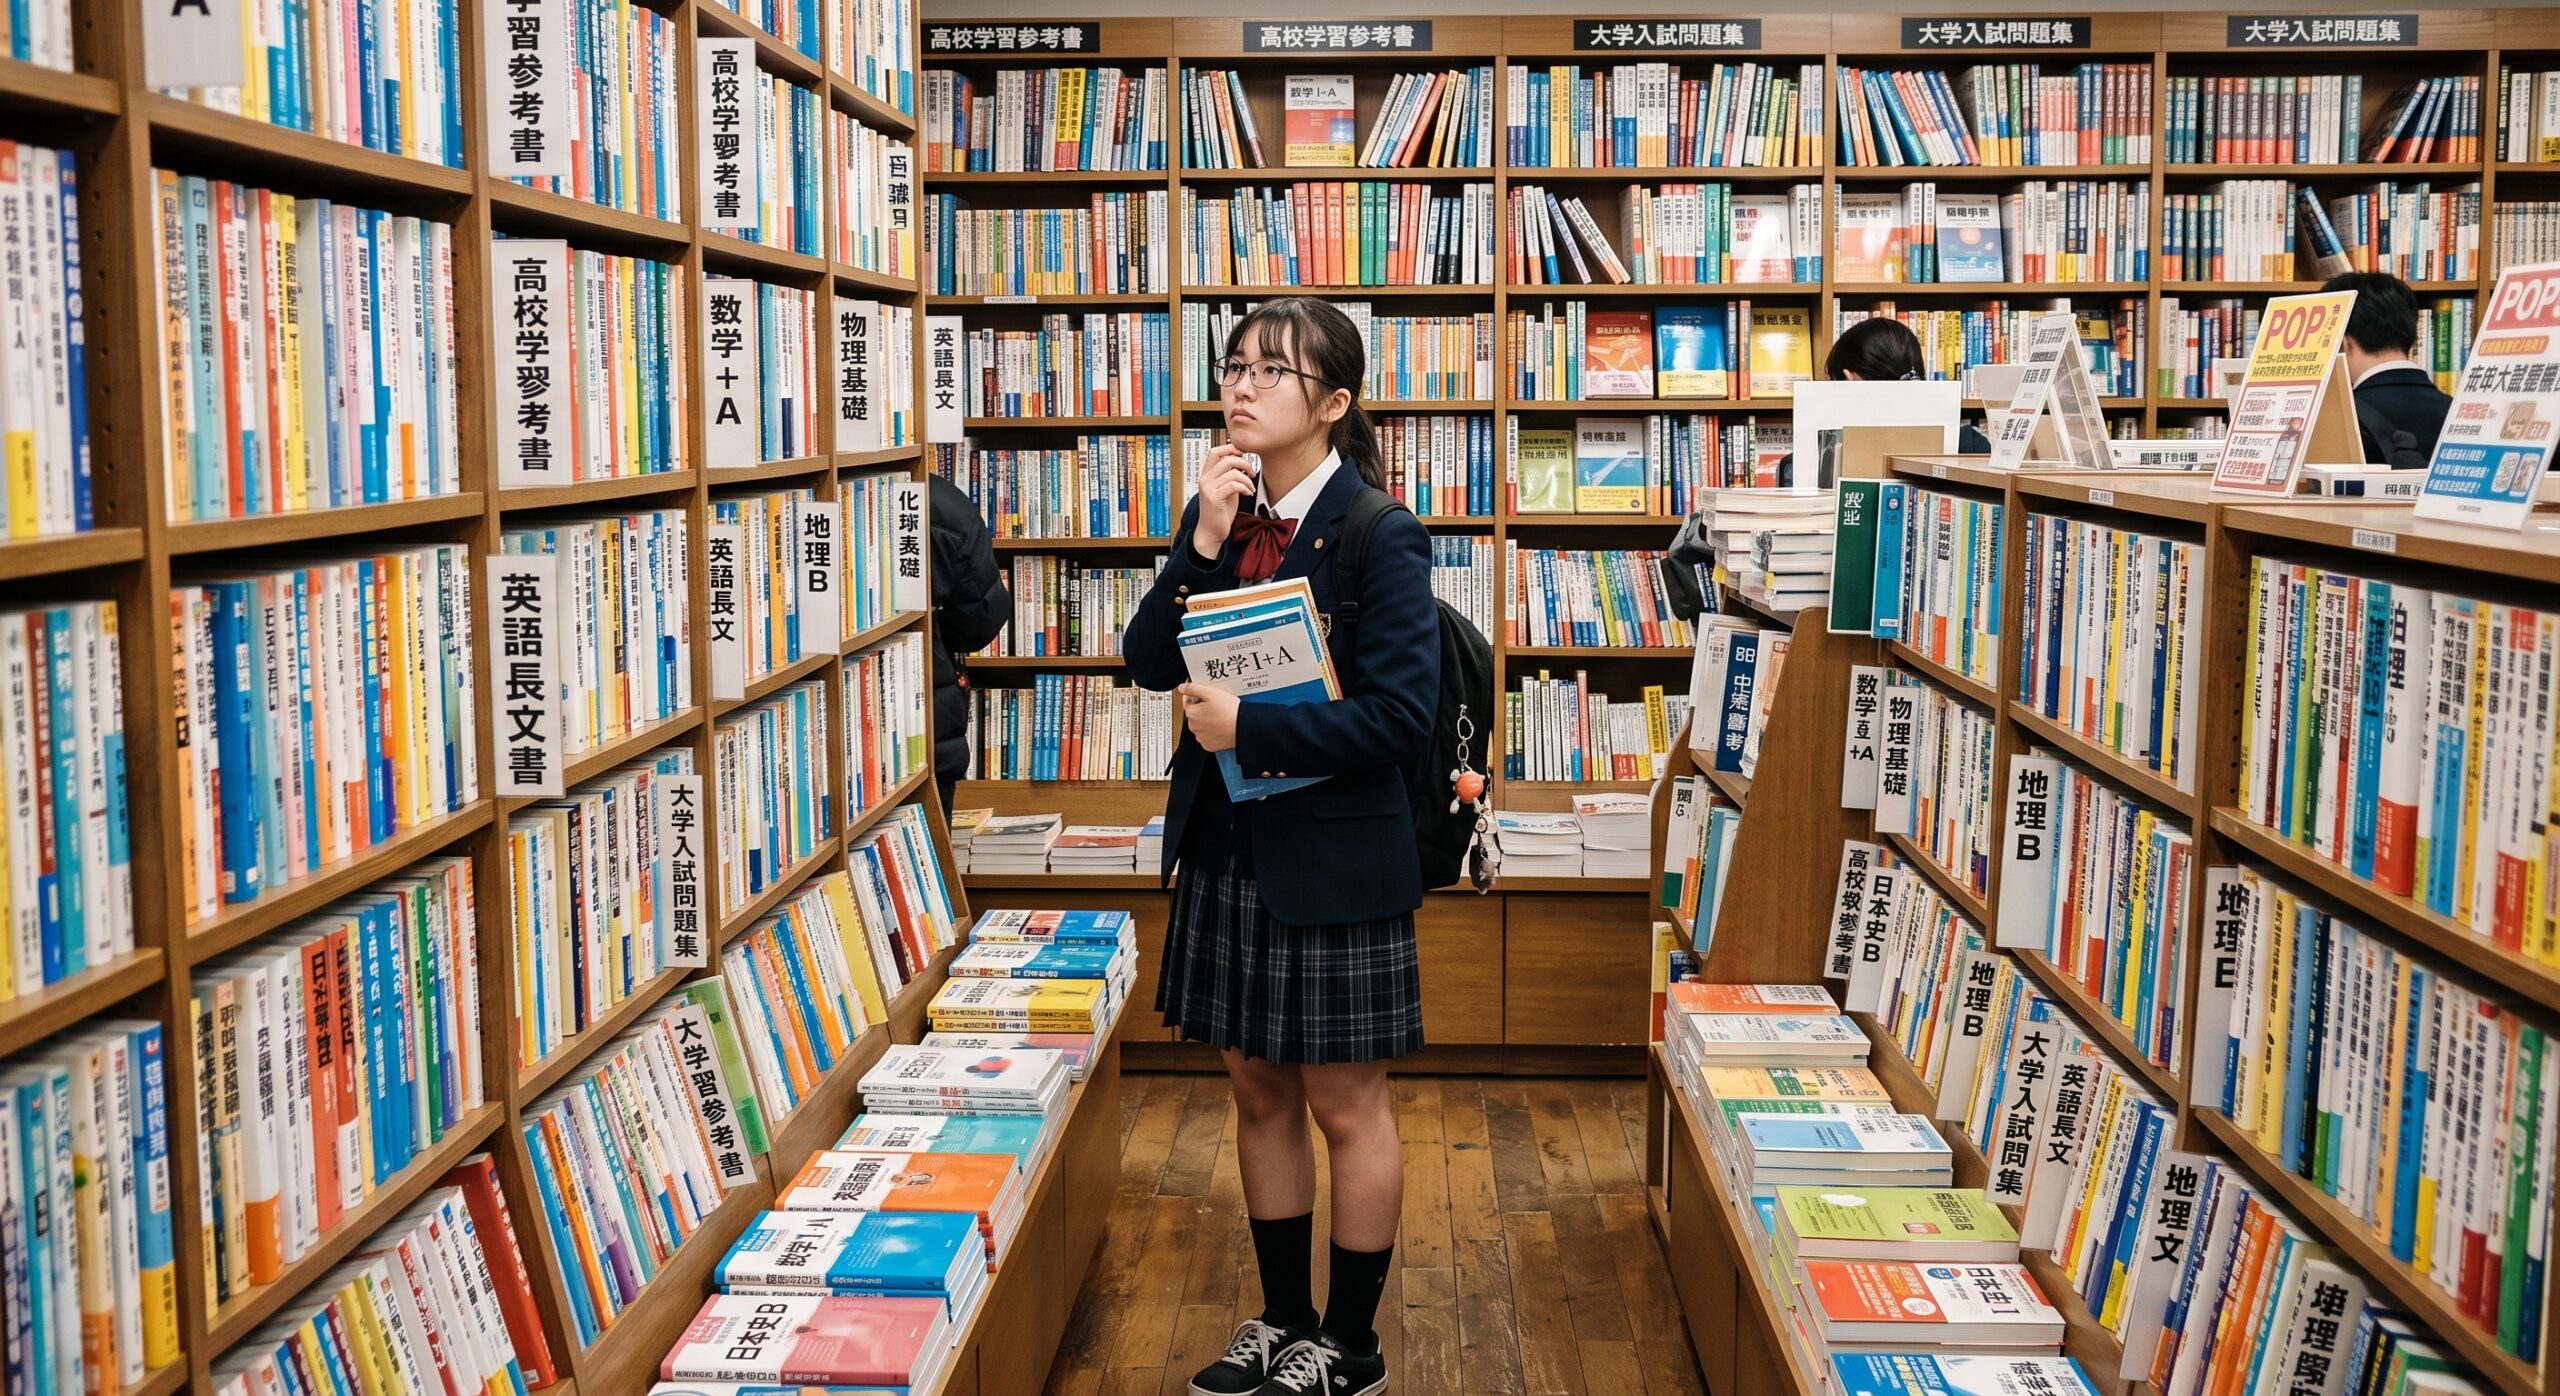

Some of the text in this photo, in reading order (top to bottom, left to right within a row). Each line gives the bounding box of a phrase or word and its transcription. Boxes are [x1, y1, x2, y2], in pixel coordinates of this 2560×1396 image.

[930, 25, 1083, 50] 高校学習参考書
[1260, 24, 1414, 49] 高校学習参考書
[1590, 23, 1745, 47] 大学入試問題集
[1918, 22, 2074, 46] 大学入試問題集
[2245, 20, 2402, 43] 大学入試問題集
[840, 311, 868, 422] 物理基礎
[2261, 304, 2327, 351] POP
[709, 537, 736, 643] 英語長文
[804, 511, 832, 594] 地理B
[501, 572, 547, 786] 英語長文書
[1883, 696, 1913, 797] 物理基礎
[2015, 768, 2049, 861] 地理B
[669, 783, 699, 959] 大学入試問題集
[1862, 875, 1894, 963] 日本史B
[1962, 959, 1996, 1038] 地理B
[673, 1016, 745, 1180] 大学習参考書
[1994, 1030, 2051, 1197] 大学入試問題集
[2045, 1063, 2089, 1166] 英語長文
[2150, 1163, 2198, 1265] 地理文
[725, 1302, 789, 1361] 日本史B
